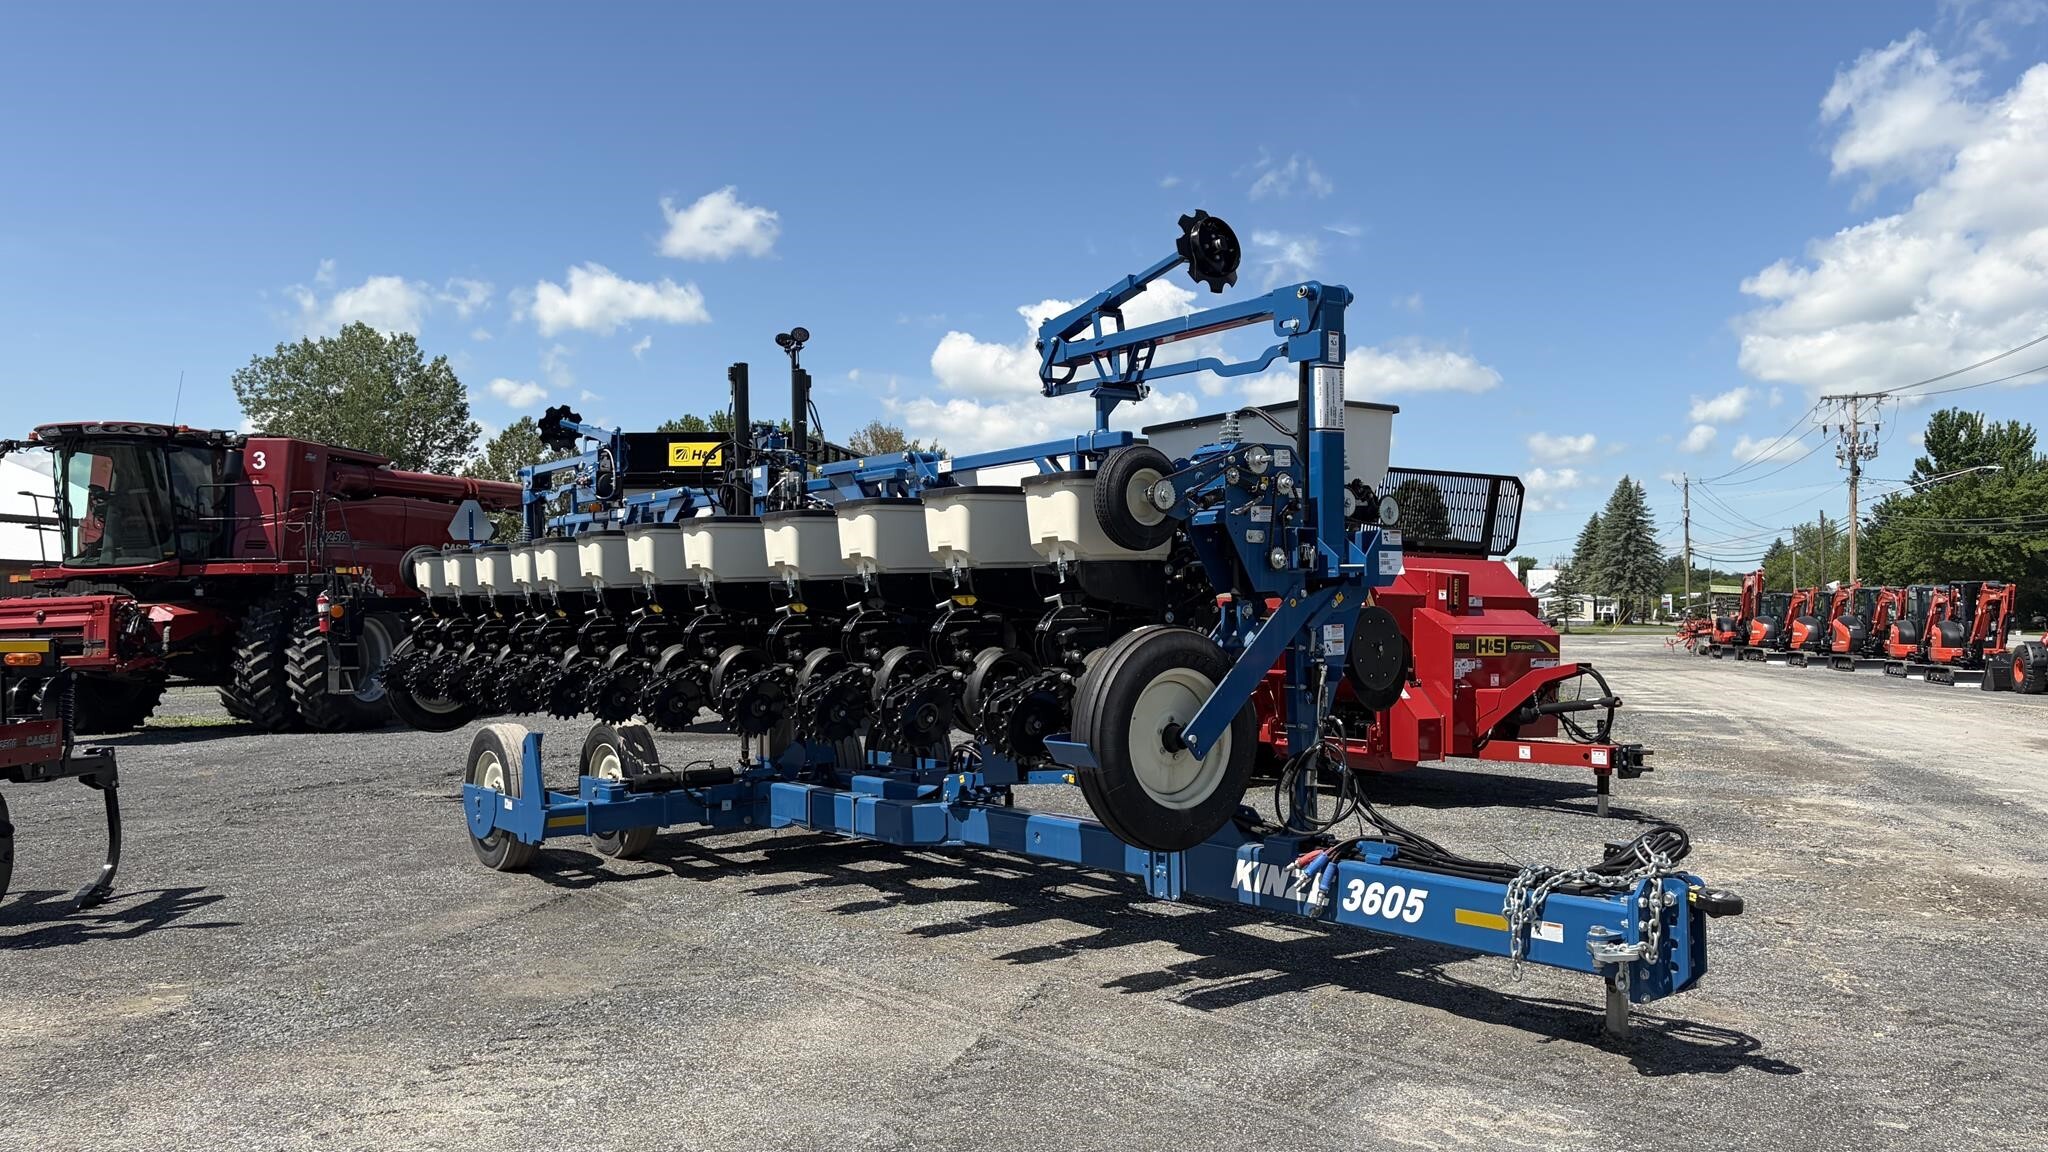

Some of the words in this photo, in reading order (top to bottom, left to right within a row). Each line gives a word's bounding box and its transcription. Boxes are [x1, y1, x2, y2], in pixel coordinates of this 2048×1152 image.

[252, 451, 266, 470] 3
[1478, 638, 1505, 653] H&S
[1342, 878, 1429, 923] 3605
